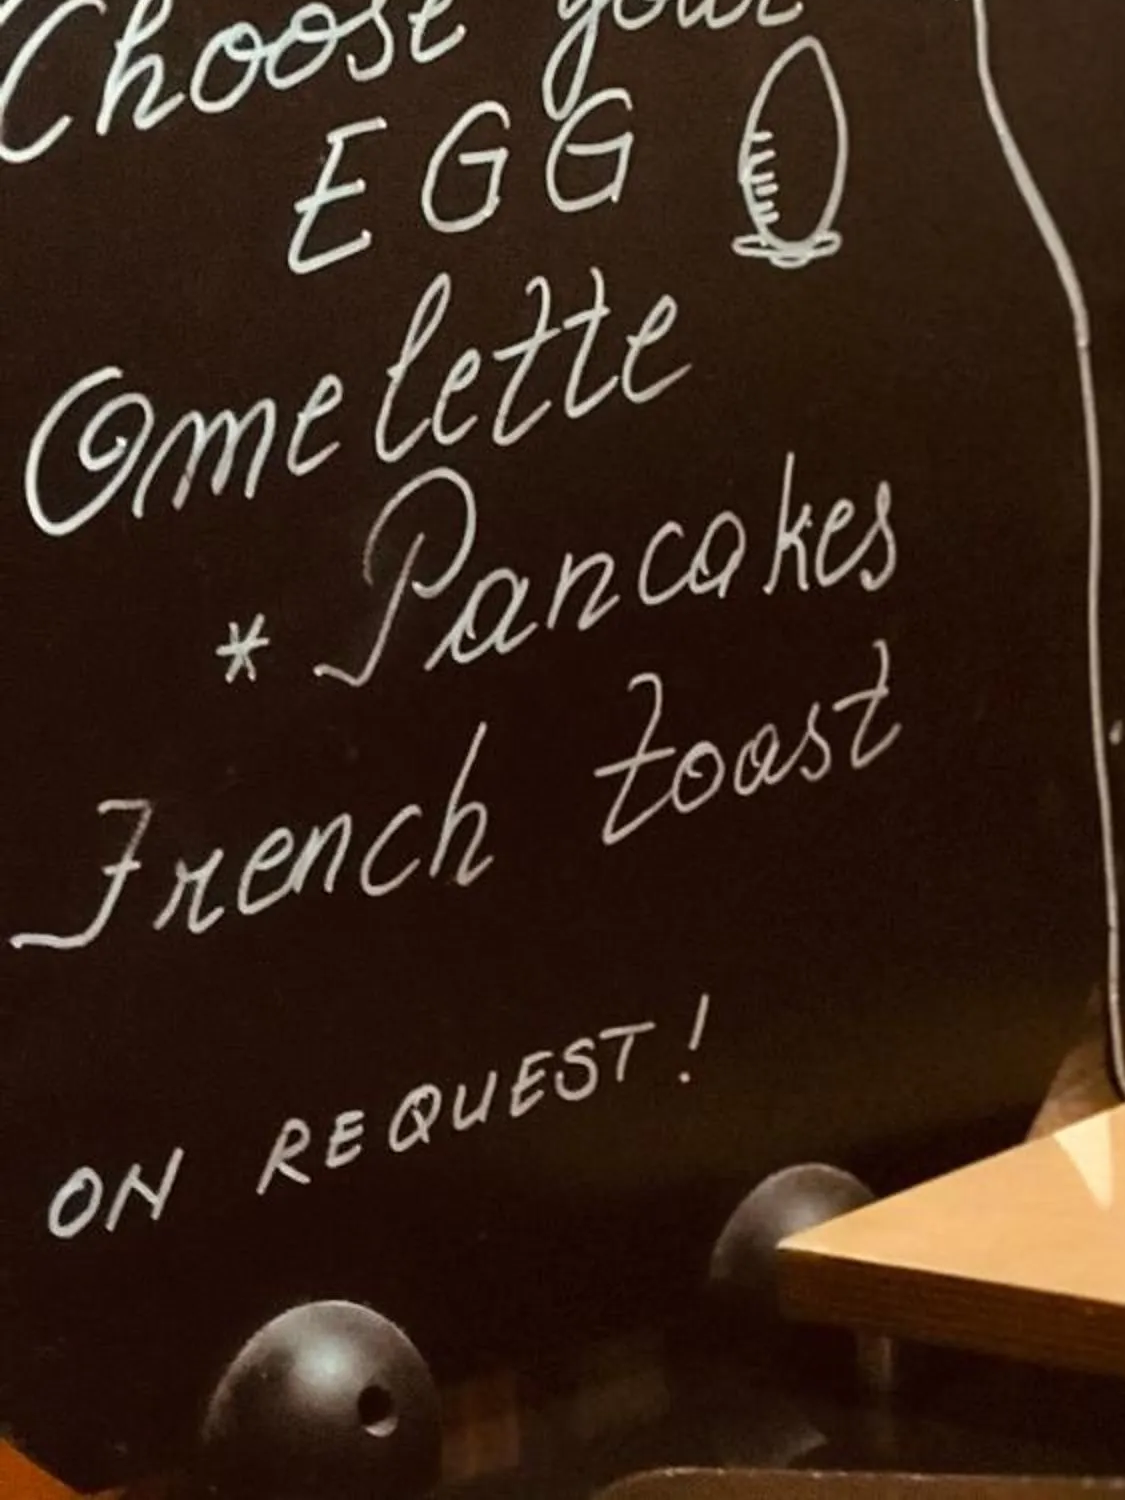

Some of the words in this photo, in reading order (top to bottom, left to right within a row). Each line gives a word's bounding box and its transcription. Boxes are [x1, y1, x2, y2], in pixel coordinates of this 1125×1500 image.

[287, 87, 636, 275] EGG
[24, 266, 693, 538] Omelette
[313, 450, 897, 688] Pancakes
[8, 720, 494, 950] French
[47, 1146, 185, 1239] ON
